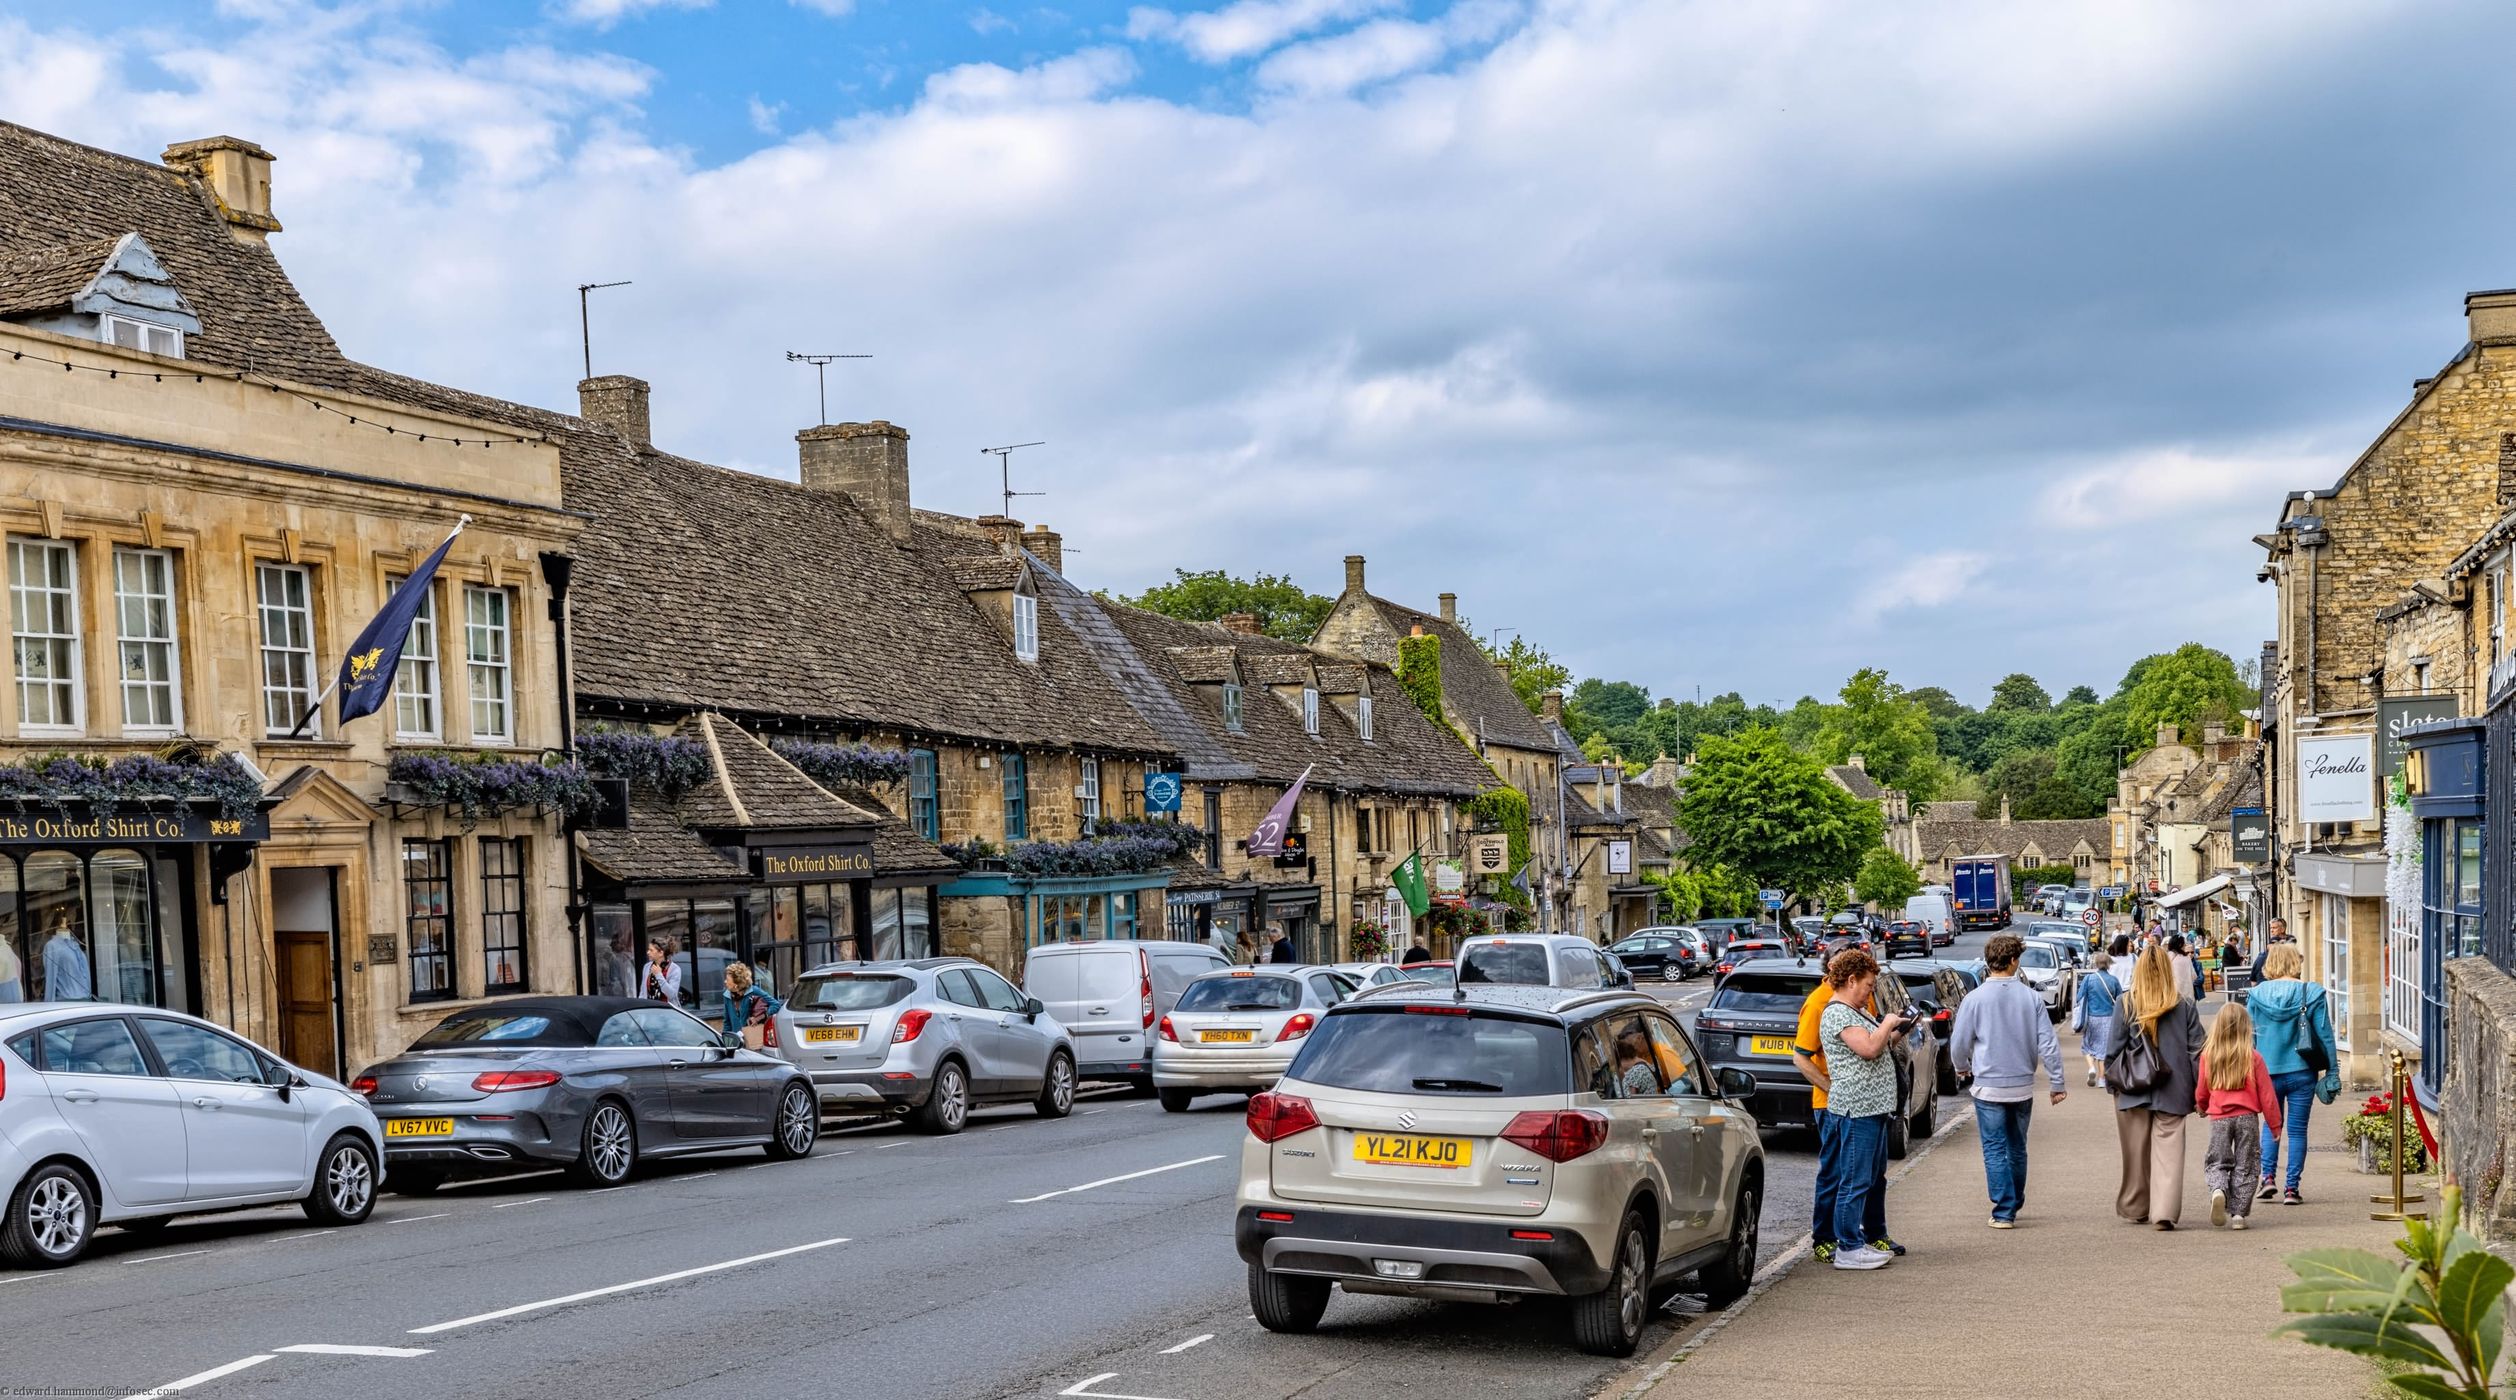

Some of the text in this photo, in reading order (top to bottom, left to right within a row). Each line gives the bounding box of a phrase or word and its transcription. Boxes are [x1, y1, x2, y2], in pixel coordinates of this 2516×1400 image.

[2304, 753, 2367, 779] fenella
[0, 818, 184, 838] The Oxford Shirt Co.
[1249, 821, 1279, 849] 52
[766, 853, 872, 873] The Oxford Shirt Co.
[1184, 891, 1214, 903] PATISSERIE
[2086, 912, 2098, 920] 20
[810, 1029, 854, 1040] VE68 EHM
[1230, 1031, 1248, 1040] TXN
[1760, 1039, 1784, 1050] WU18
[392, 1120, 448, 1134] LV67 VVC
[1367, 1135, 1458, 1162] YL21 KJO
